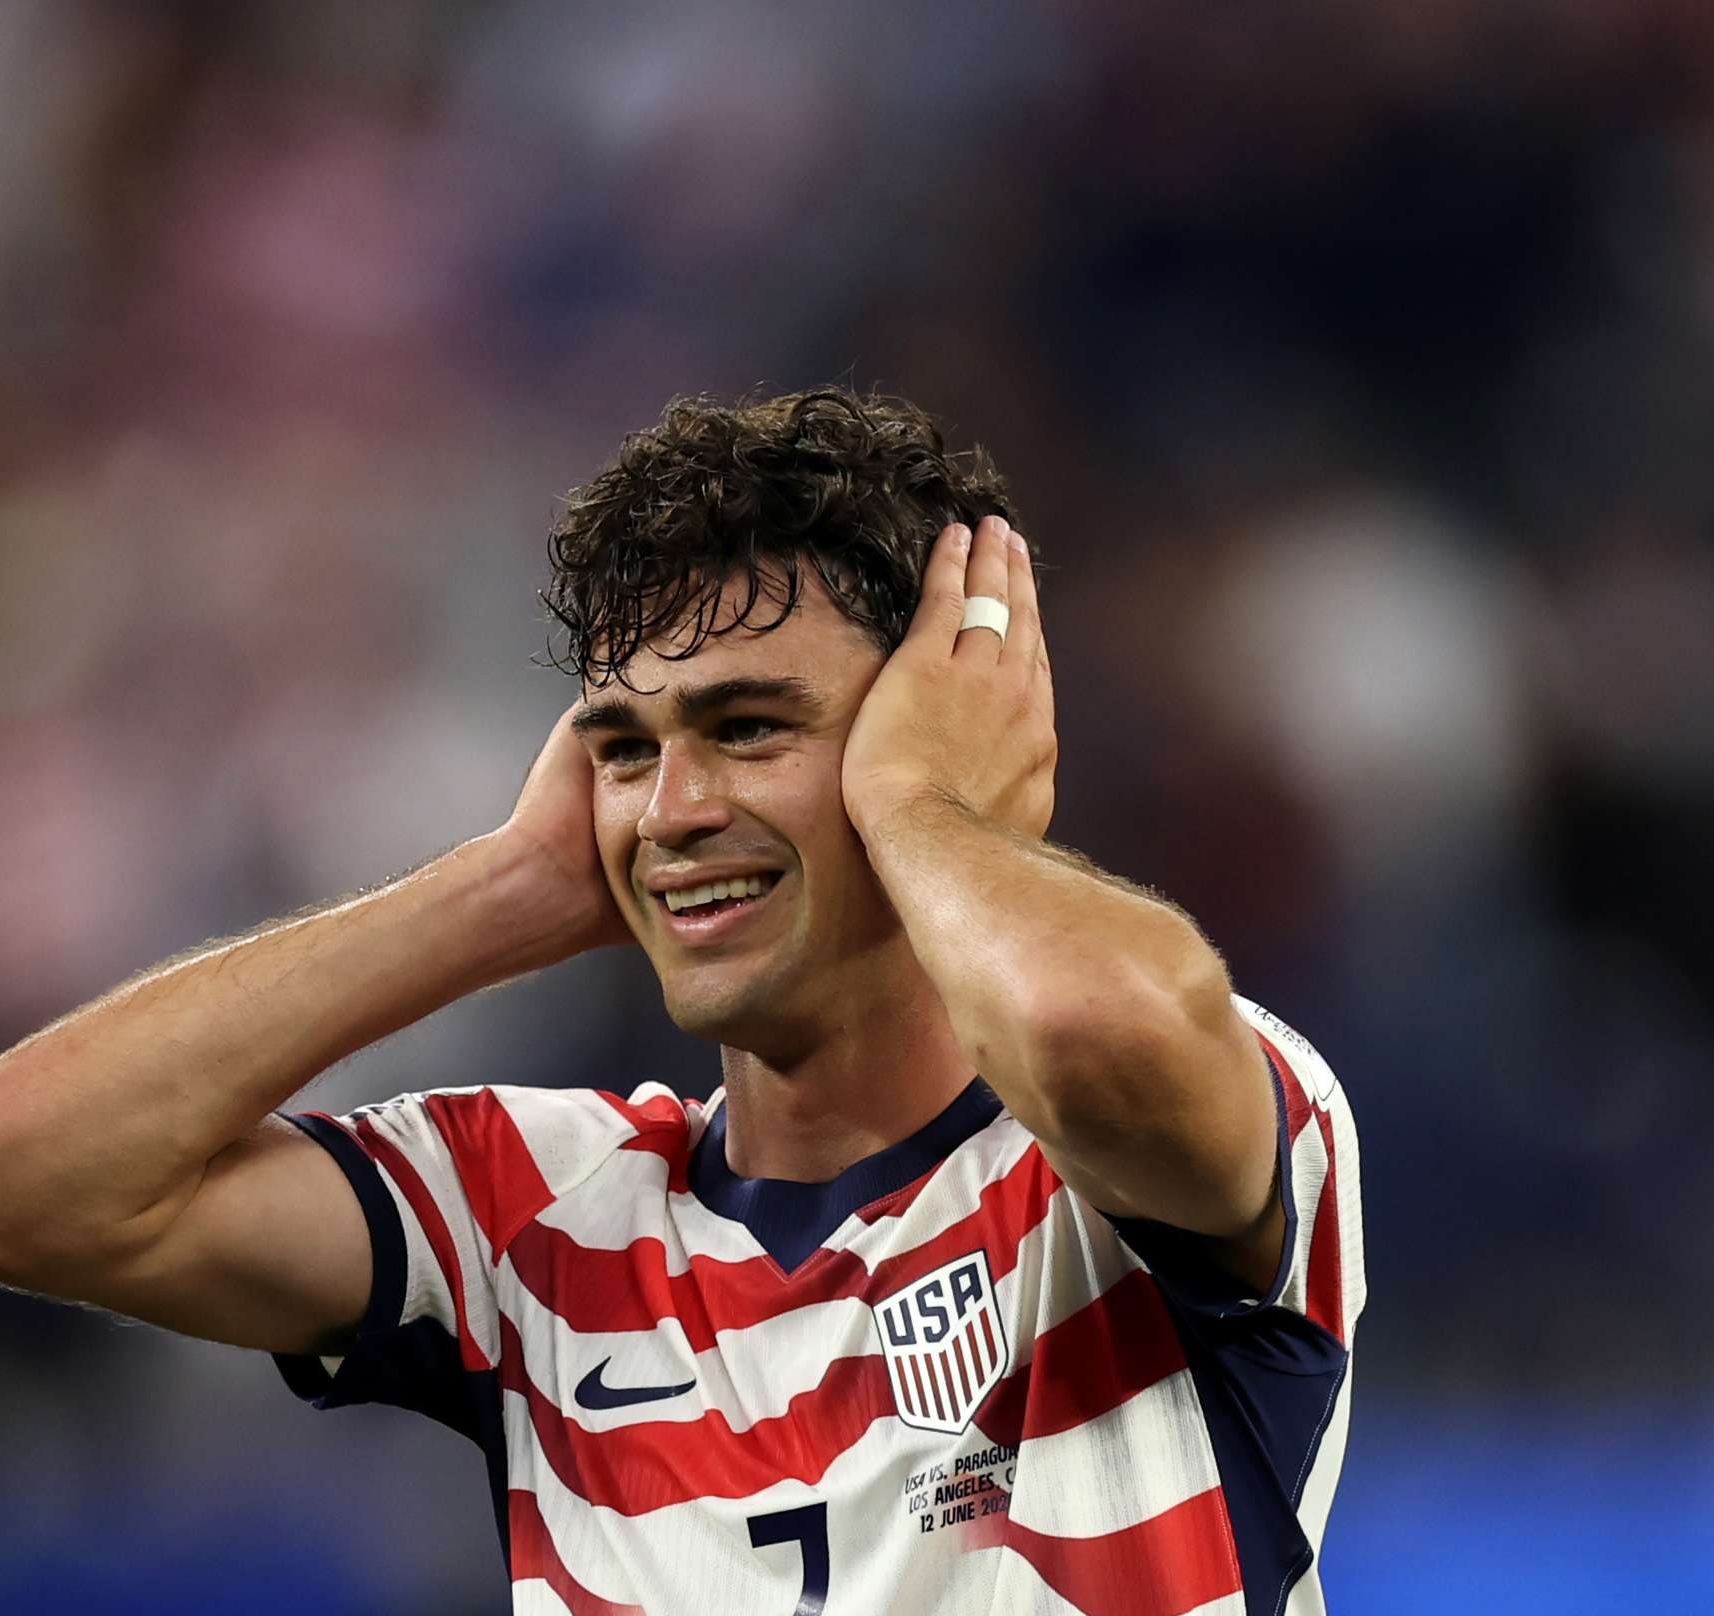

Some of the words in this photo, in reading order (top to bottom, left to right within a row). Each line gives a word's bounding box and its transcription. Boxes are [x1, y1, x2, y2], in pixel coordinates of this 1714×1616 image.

[883, 1262, 983, 1347] USA
[905, 1472, 927, 1494] USA
[954, 1445, 1020, 1476] PARAGUA
[909, 1491, 928, 1515] LOS
[920, 1514, 935, 1533] 12
[940, 1501, 976, 1528] JUNE
[981, 1493, 1011, 1516] 202
